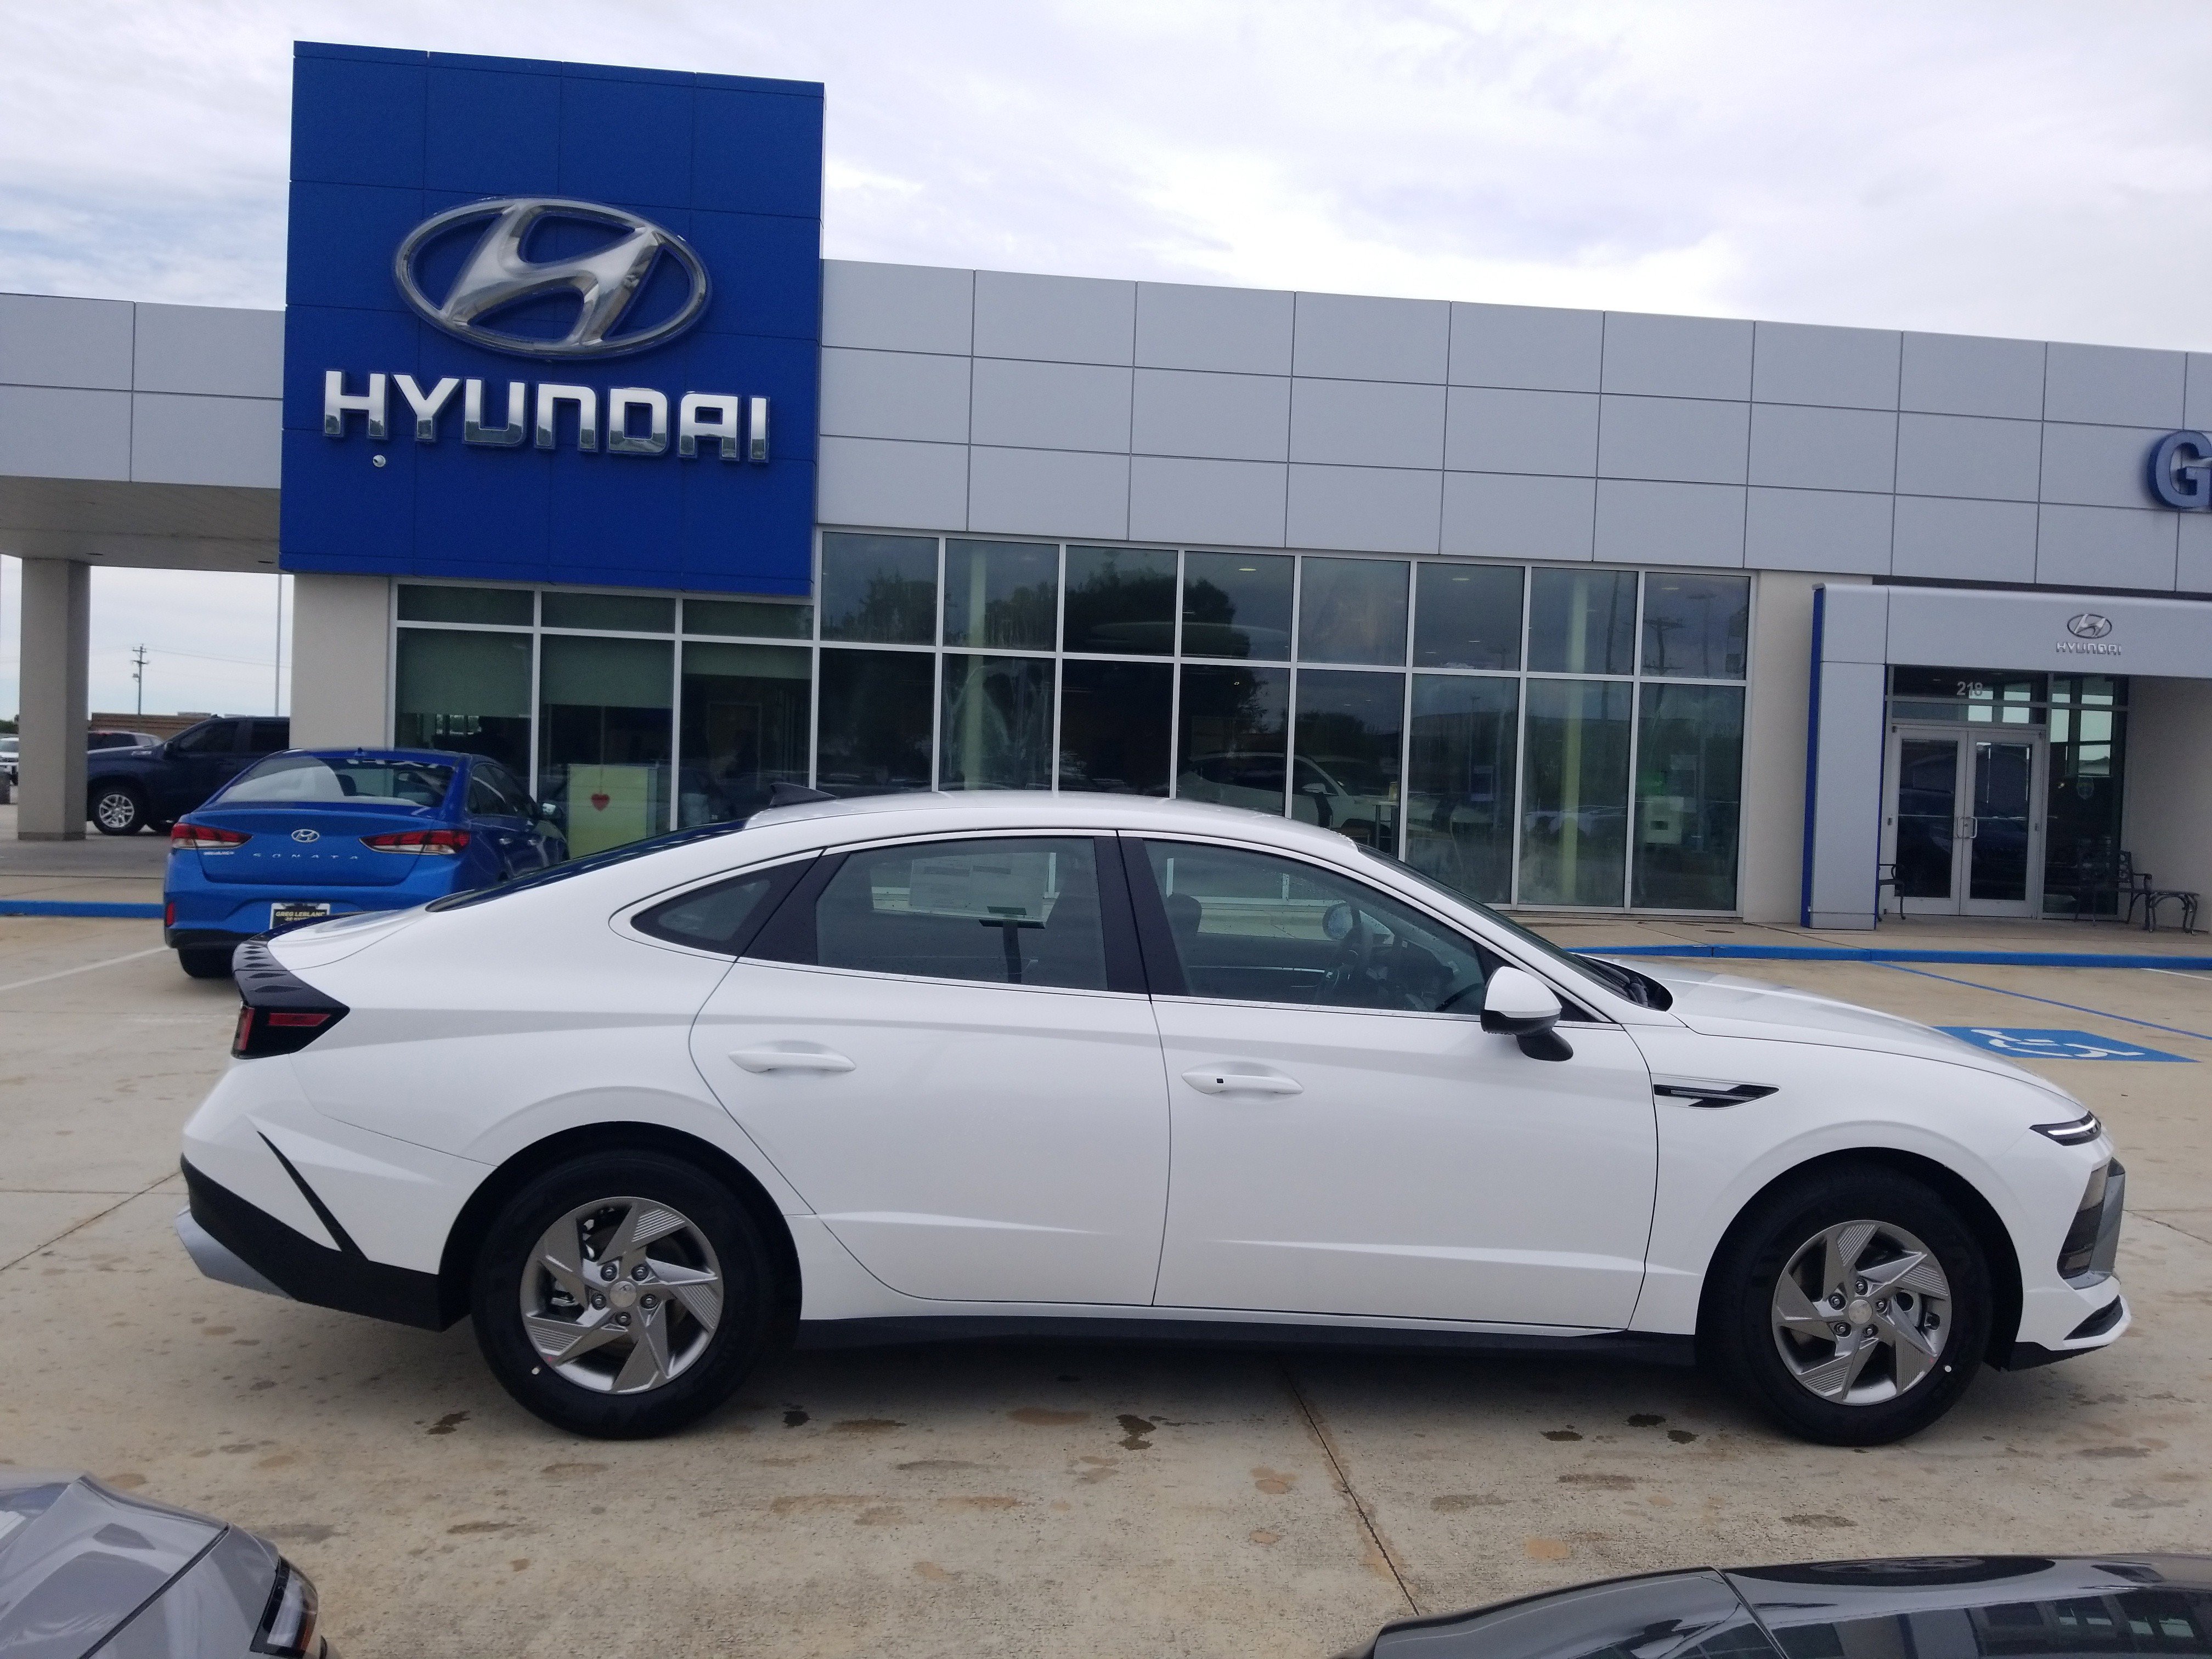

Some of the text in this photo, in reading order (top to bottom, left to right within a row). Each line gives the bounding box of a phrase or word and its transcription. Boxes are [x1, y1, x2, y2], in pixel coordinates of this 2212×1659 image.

[323, 370, 770, 462] HYUNDAI
[2056, 641, 2121, 655] HYUNDAI
[1957, 681, 1983, 696] 218
